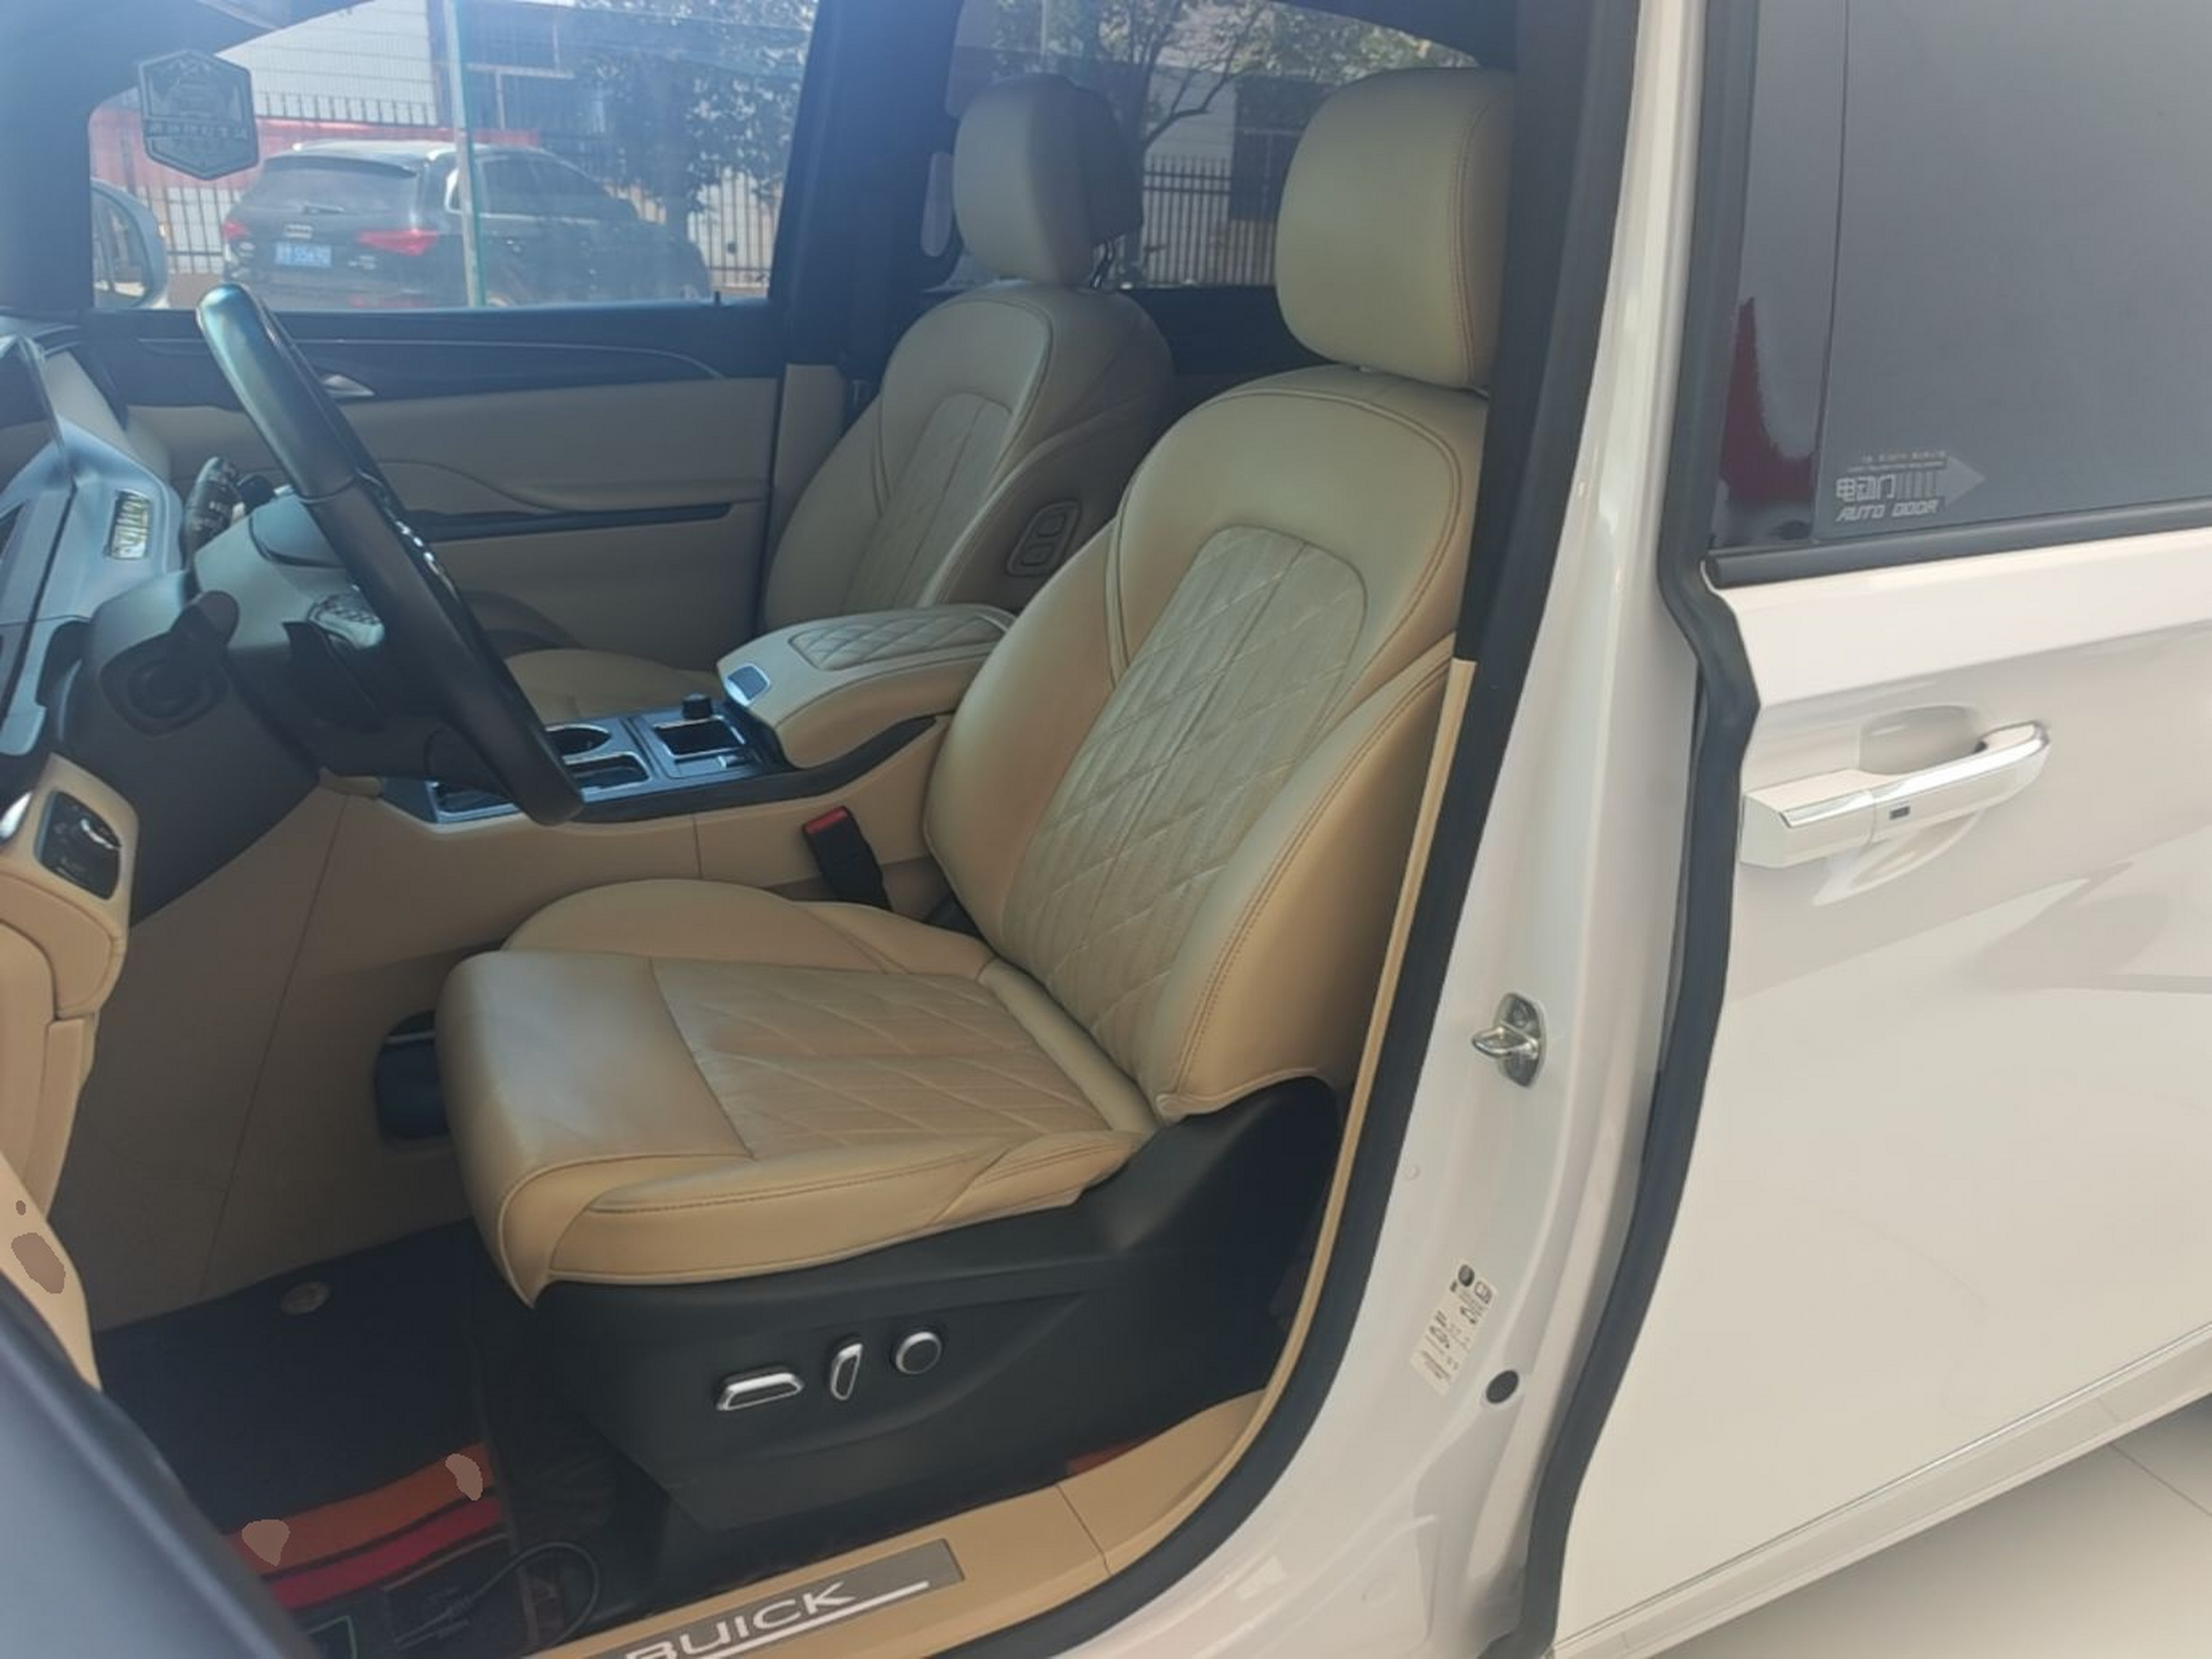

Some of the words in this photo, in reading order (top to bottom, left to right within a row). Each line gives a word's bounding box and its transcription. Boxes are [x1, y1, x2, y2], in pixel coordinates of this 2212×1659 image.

[1836, 474, 1896, 502] 电动门
[1836, 505, 1885, 521] AUTO
[1892, 499, 1939, 517] DOOR
